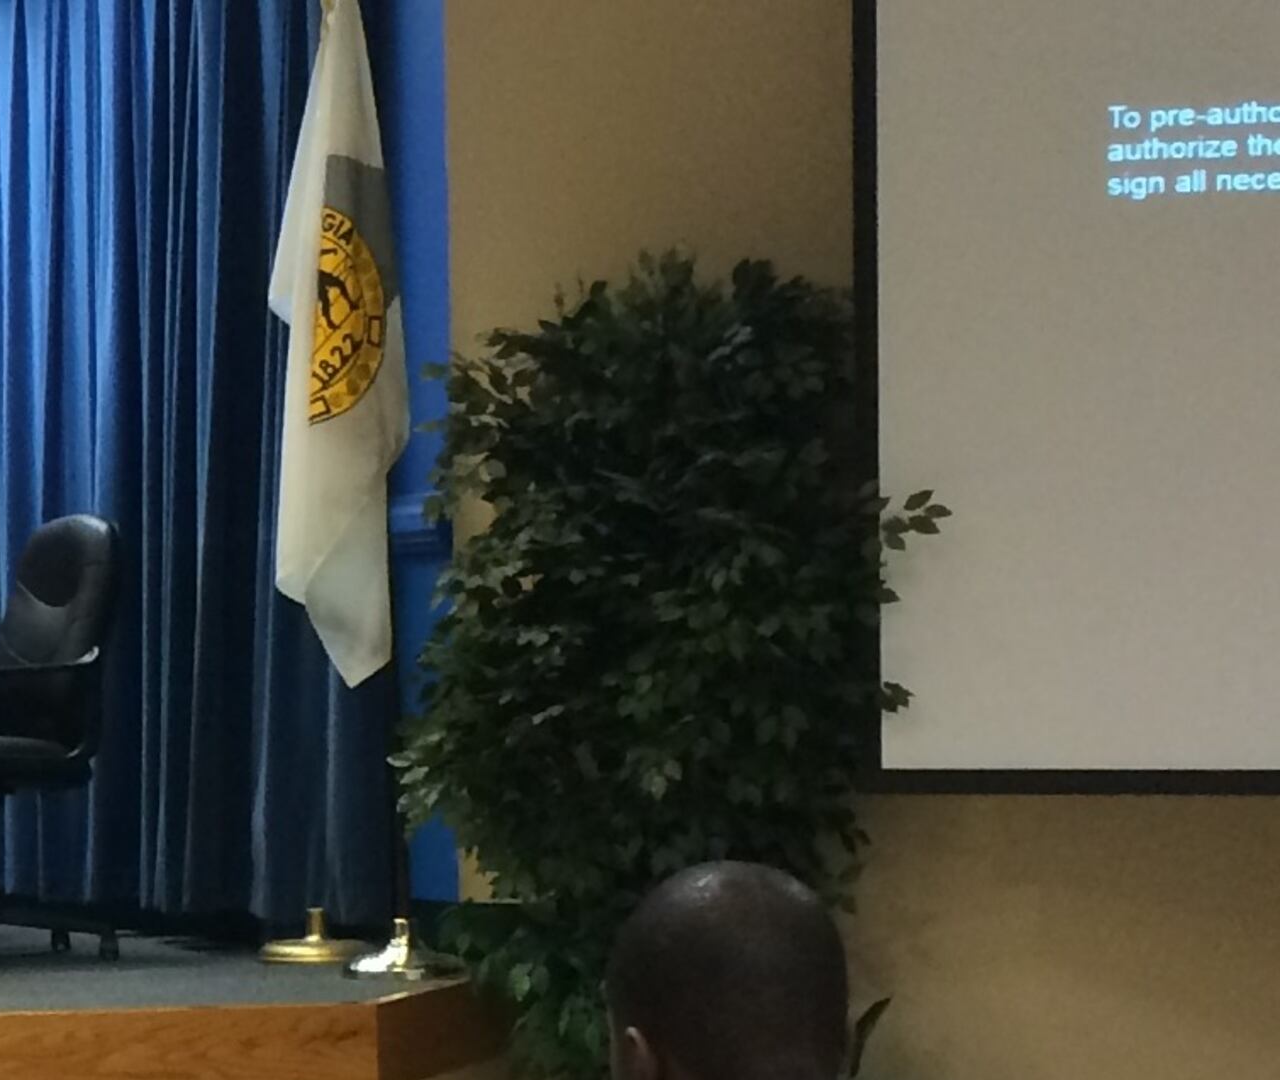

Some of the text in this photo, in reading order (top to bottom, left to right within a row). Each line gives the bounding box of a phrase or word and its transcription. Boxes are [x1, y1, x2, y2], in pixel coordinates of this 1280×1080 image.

[1107, 104, 1141, 129] To
[1107, 136, 1238, 162] authorize
[1107, 169, 1280, 200] sign all nece
[311, 333, 363, 391] 1822
